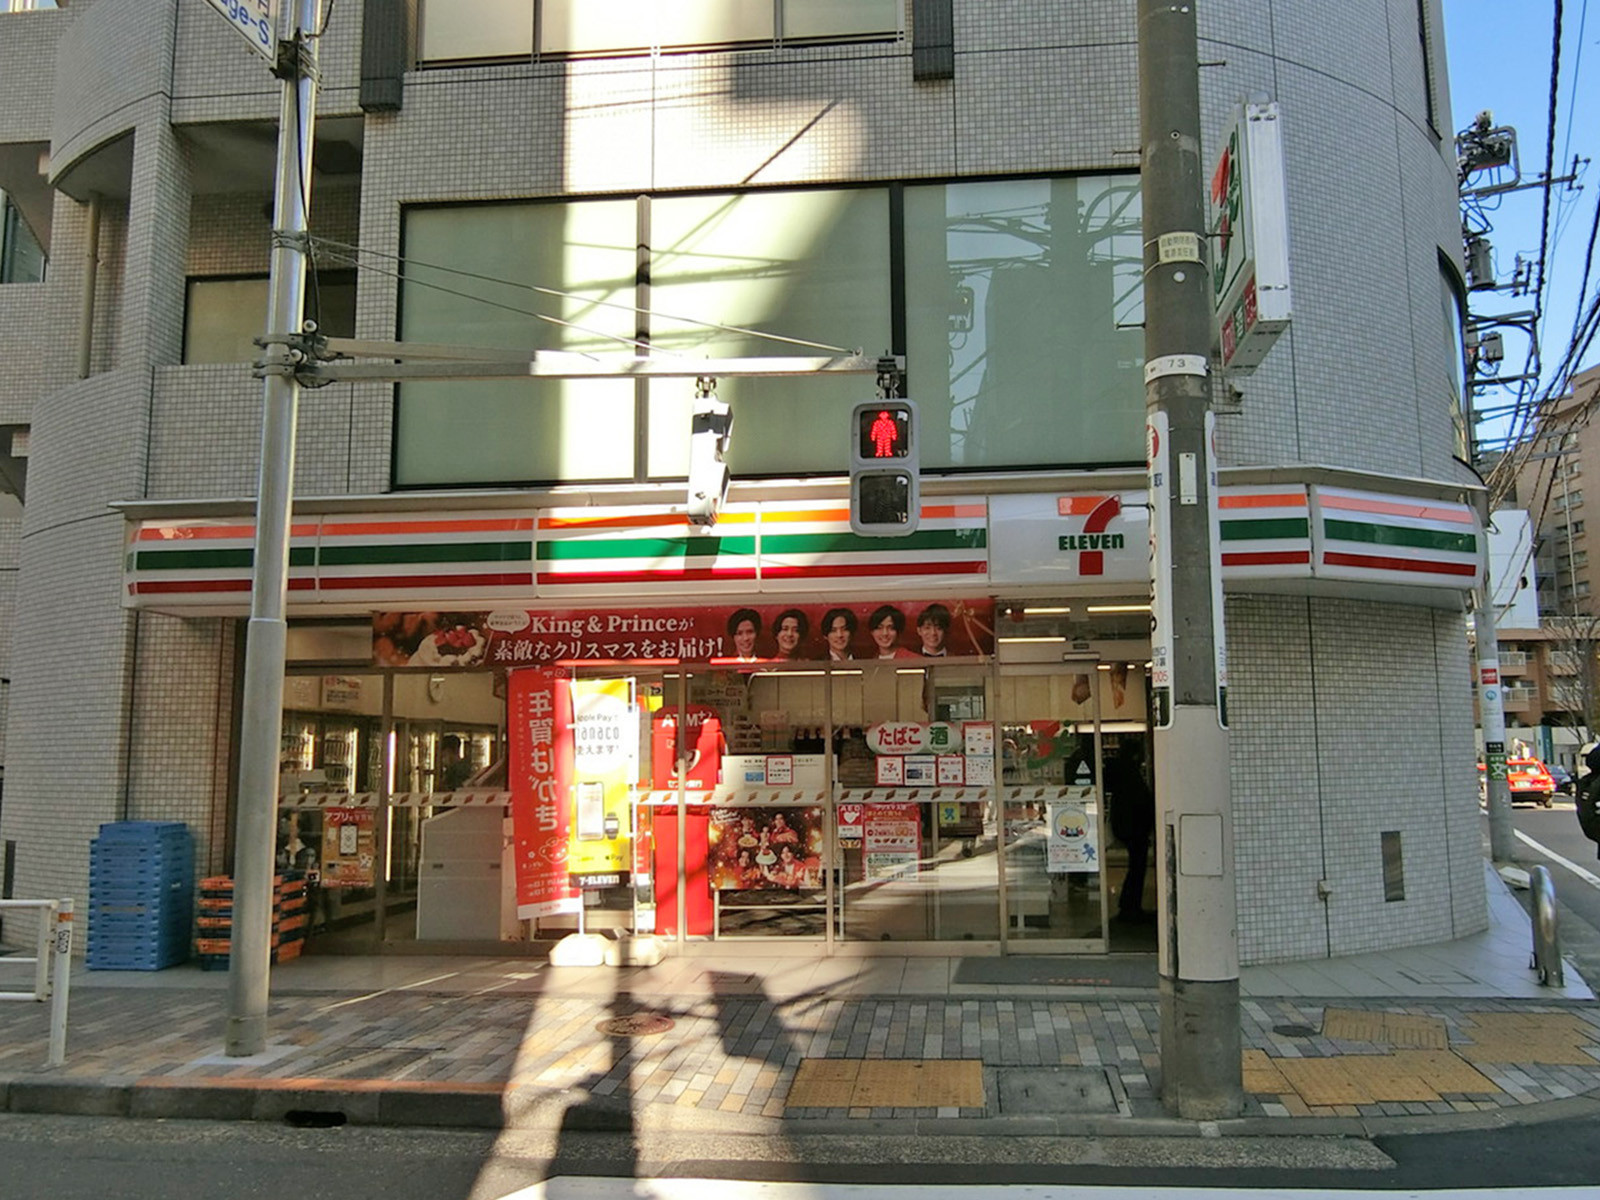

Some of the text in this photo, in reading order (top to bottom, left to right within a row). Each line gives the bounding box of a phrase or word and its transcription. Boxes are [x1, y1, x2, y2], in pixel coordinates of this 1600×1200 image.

[1168, 358, 1186, 368] 73
[531, 616, 585, 638] King
[878, 726, 921, 746] たばこ
[930, 726, 949, 745] 酒
